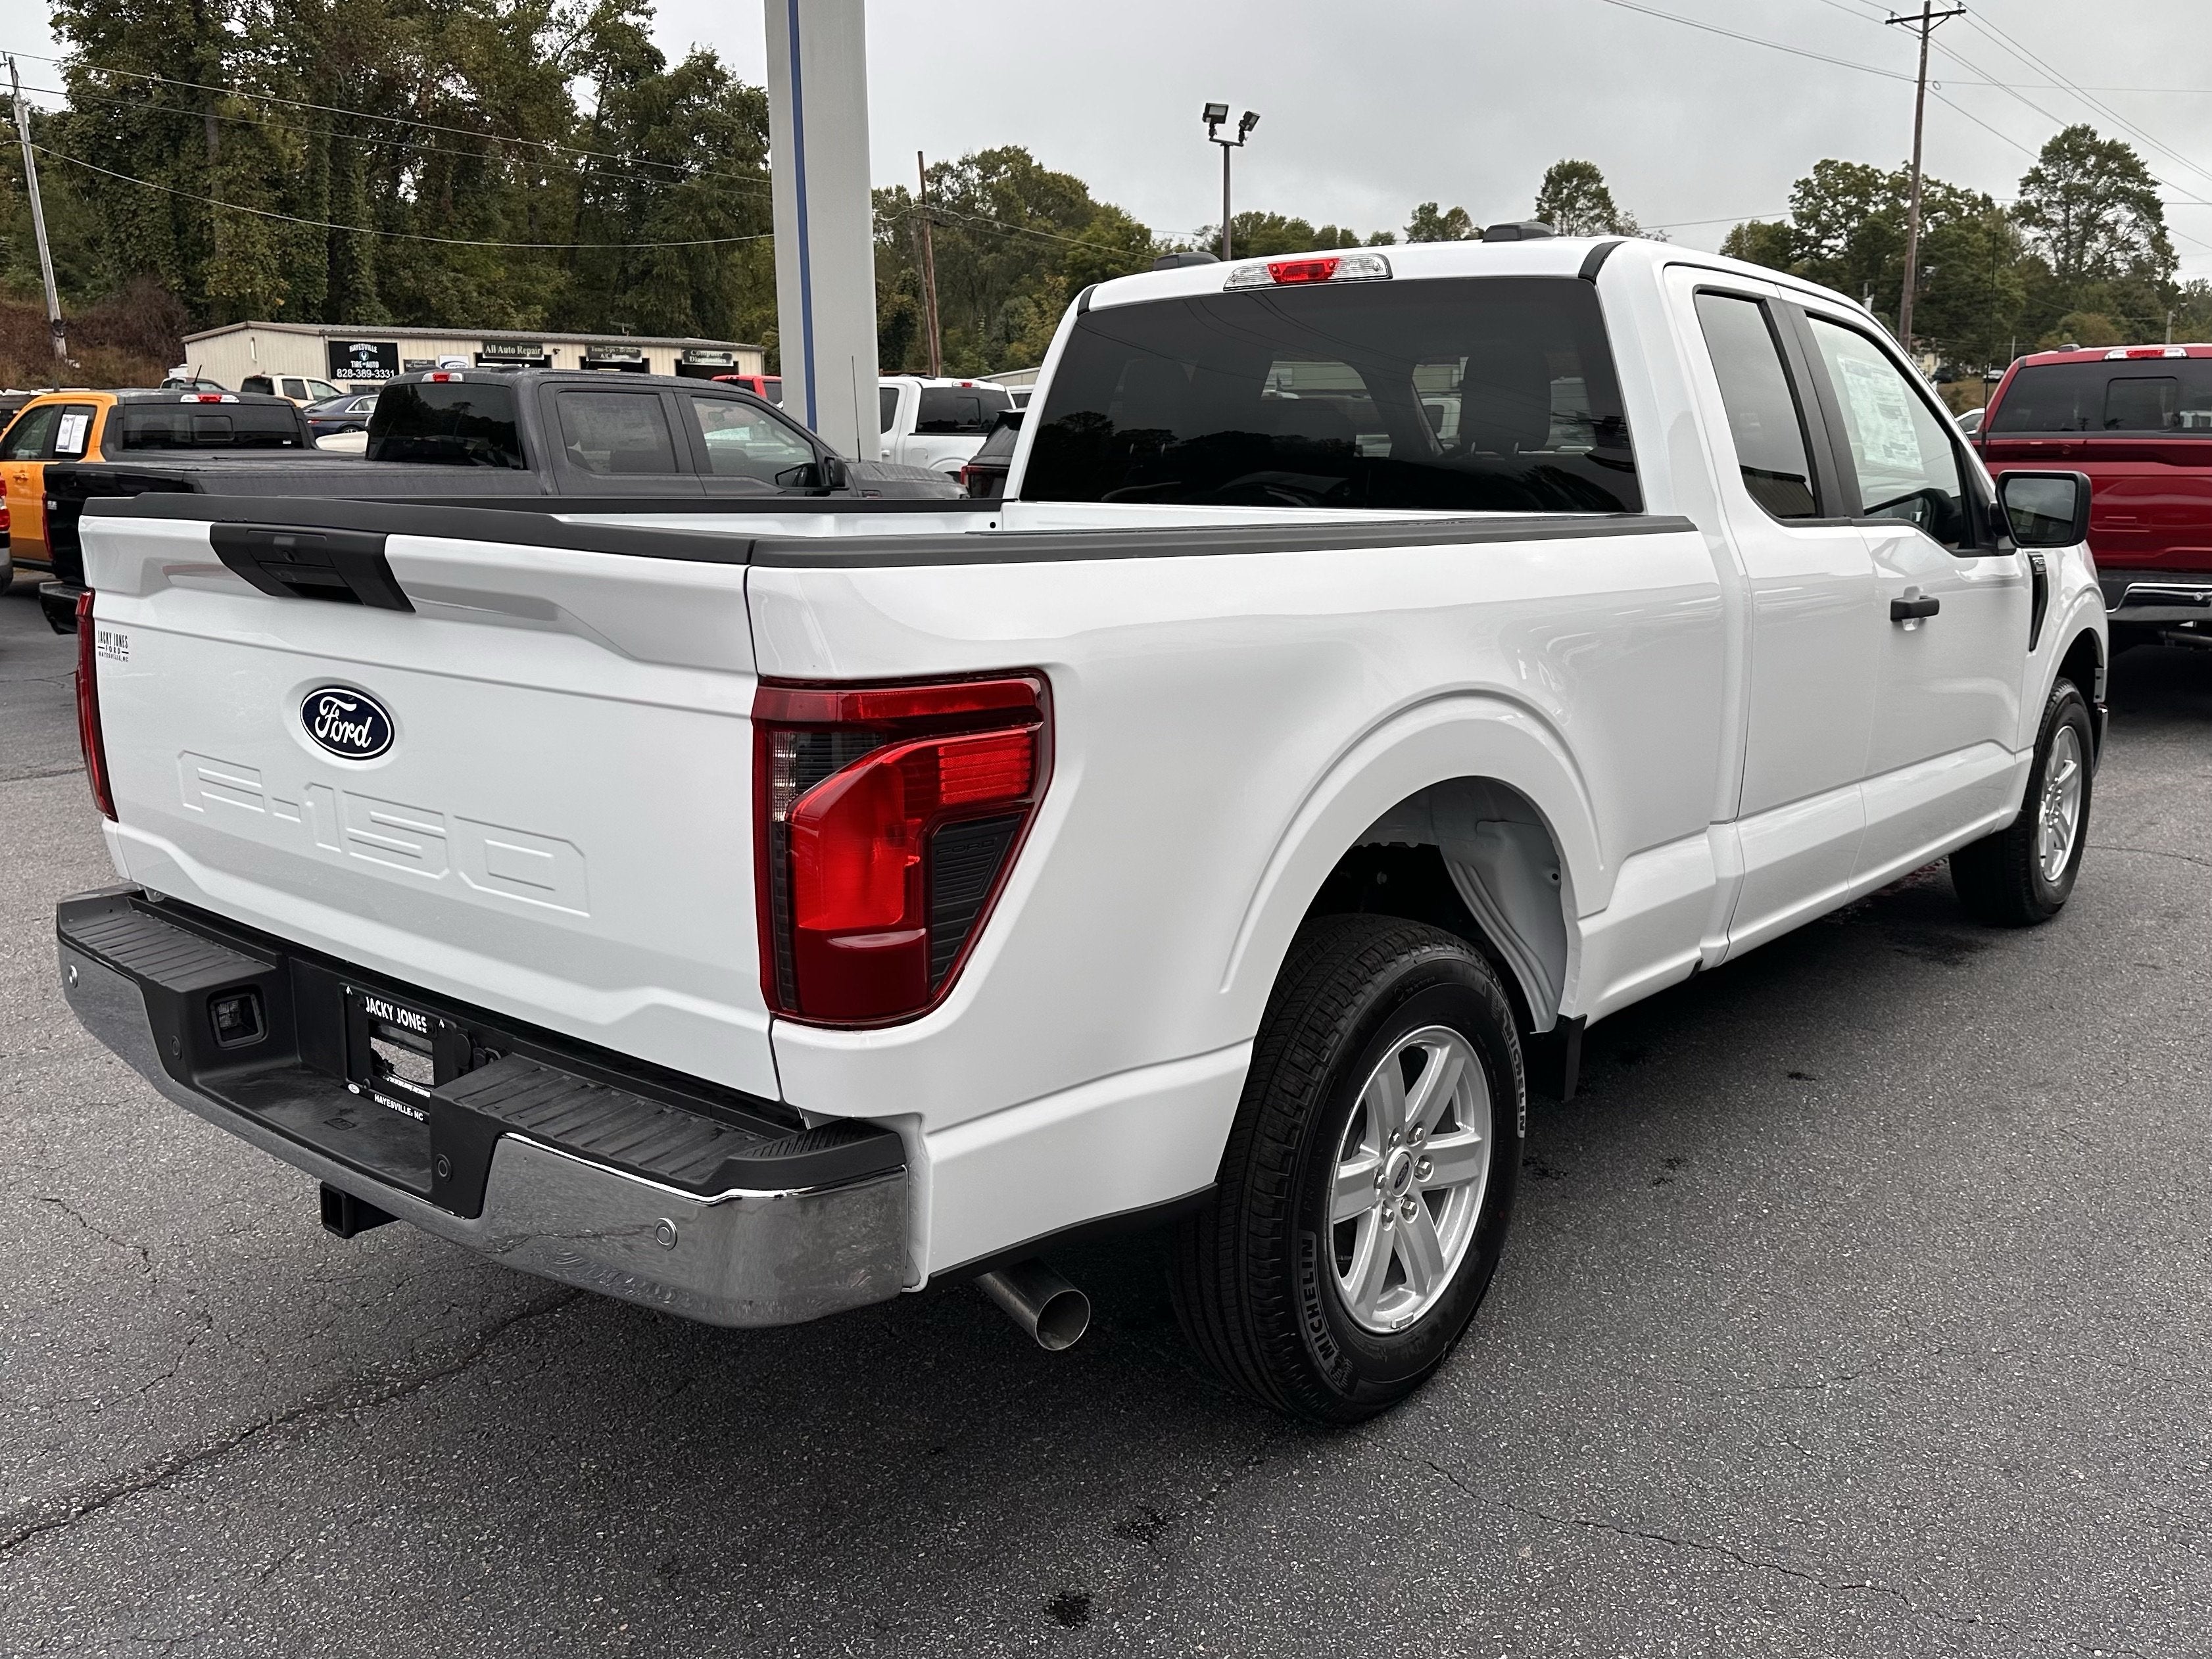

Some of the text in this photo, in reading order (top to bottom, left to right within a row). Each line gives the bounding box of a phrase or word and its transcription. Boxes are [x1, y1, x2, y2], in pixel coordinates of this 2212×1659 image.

[485, 345, 541, 357] All Auto Repair
[336, 368, 395, 378] 828-389-3331
[98, 630, 128, 649] JACKY JONES
[105, 644, 121, 655] FORD
[314, 696, 373, 748] Ford
[178, 750, 590, 917] F-150
[366, 996, 427, 1034] JACKY JONES
[414, 1110, 423, 1121] NC
[1301, 1238, 1335, 1361] MICHELIN
